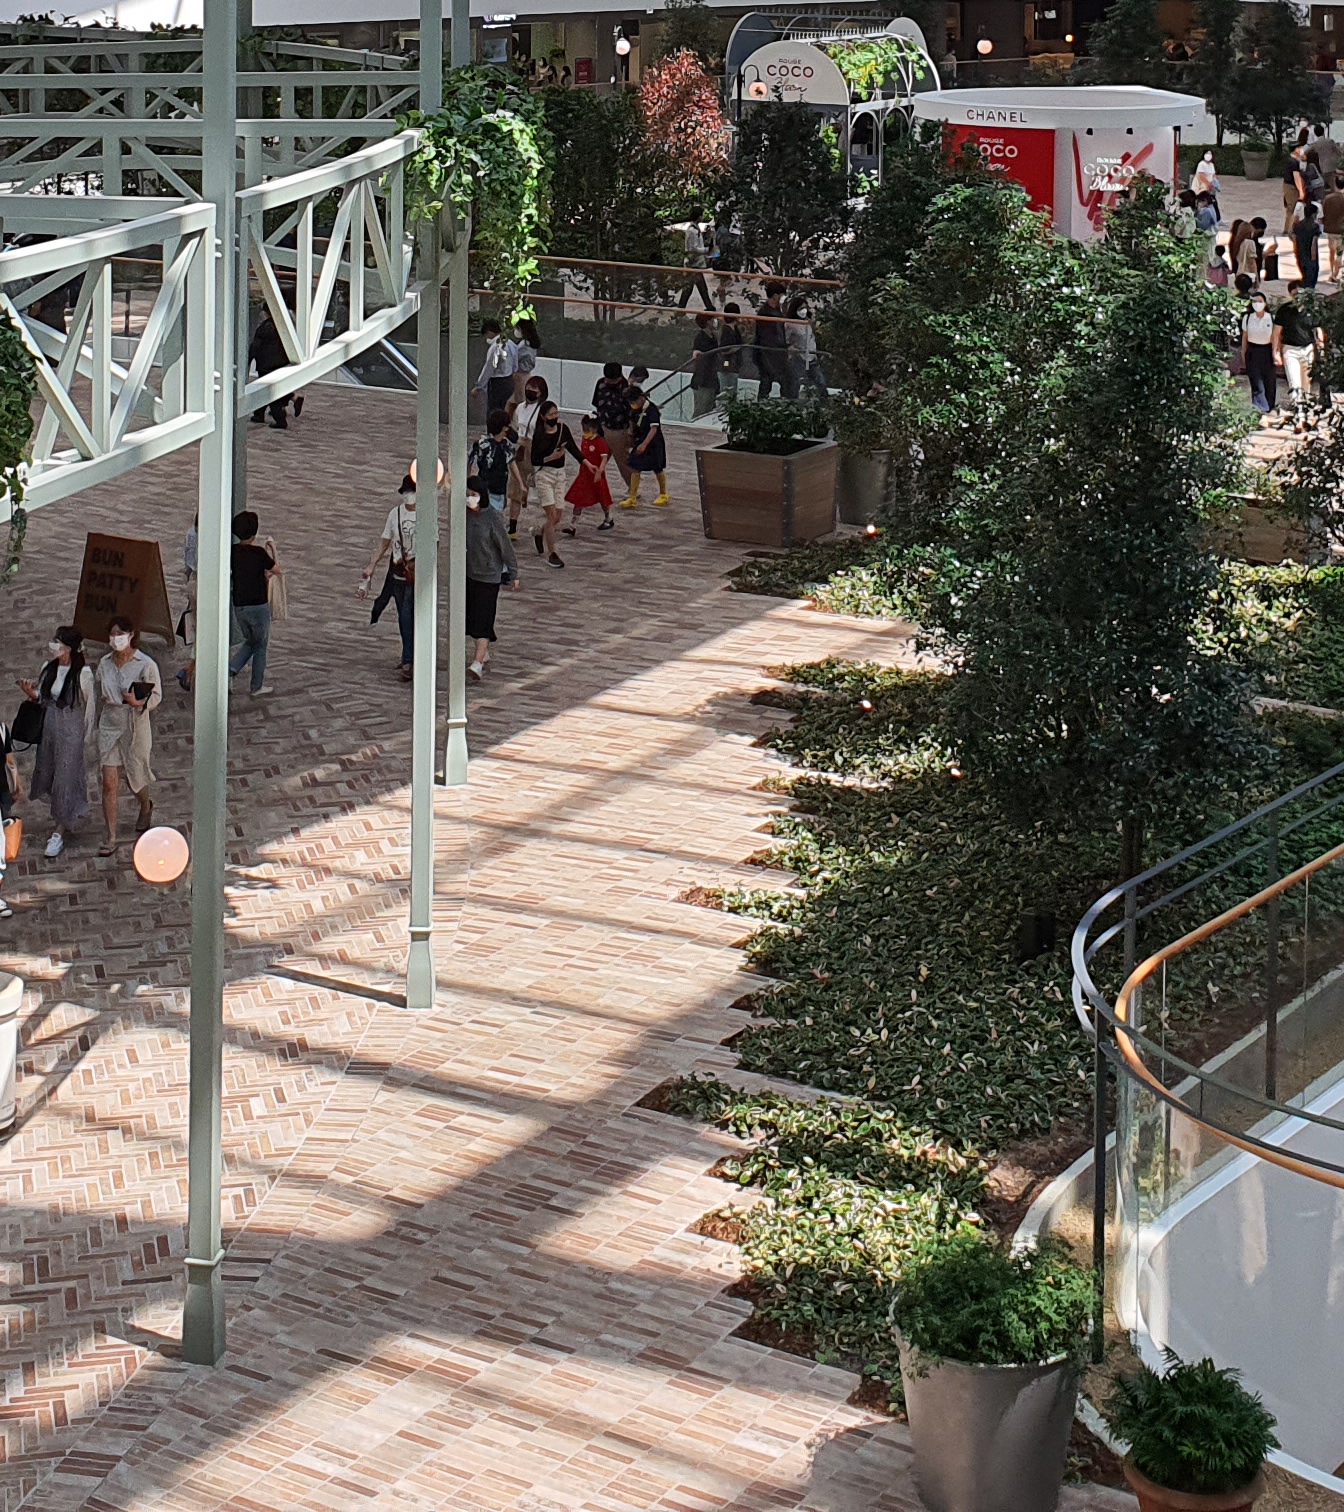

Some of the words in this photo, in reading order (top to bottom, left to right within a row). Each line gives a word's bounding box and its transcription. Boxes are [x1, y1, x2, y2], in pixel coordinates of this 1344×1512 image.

[767, 64, 814, 78] COCO
[967, 109, 1027, 123] CHANEL
[979, 144, 1018, 158] OCO
[1083, 163, 1135, 176] COCO
[91, 546, 124, 568] BUN
[87, 570, 139, 594] PATTY
[83, 592, 117, 614] BUN
